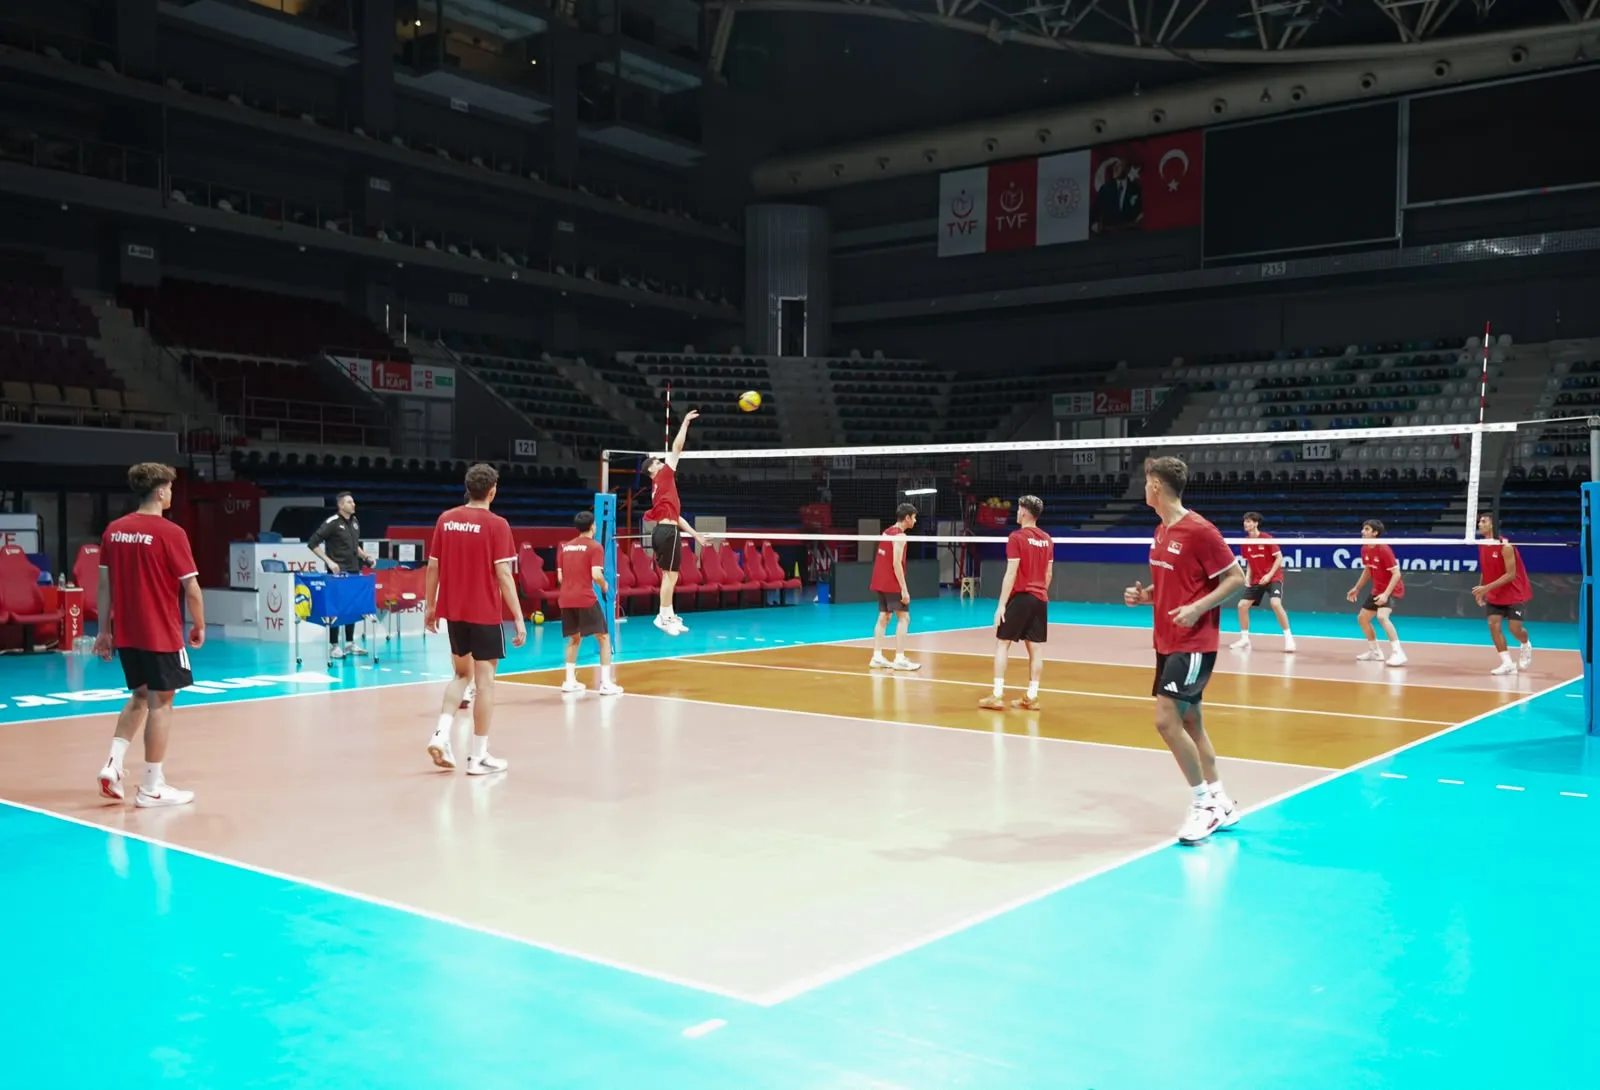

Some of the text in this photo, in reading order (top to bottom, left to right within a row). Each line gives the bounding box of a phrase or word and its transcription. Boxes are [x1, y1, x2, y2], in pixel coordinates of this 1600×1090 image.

[946, 220, 978, 237] TVF
[995, 213, 1029, 231] TVF
[1096, 392, 1109, 413] 2
[518, 442, 535, 453] 121
[1306, 445, 1328, 456] 117
[1074, 453, 1093, 463] 118
[443, 520, 481, 533] TÜRKİYE
[110, 530, 153, 545] TÜRKİYE
[265, 616, 285, 630] TVF
